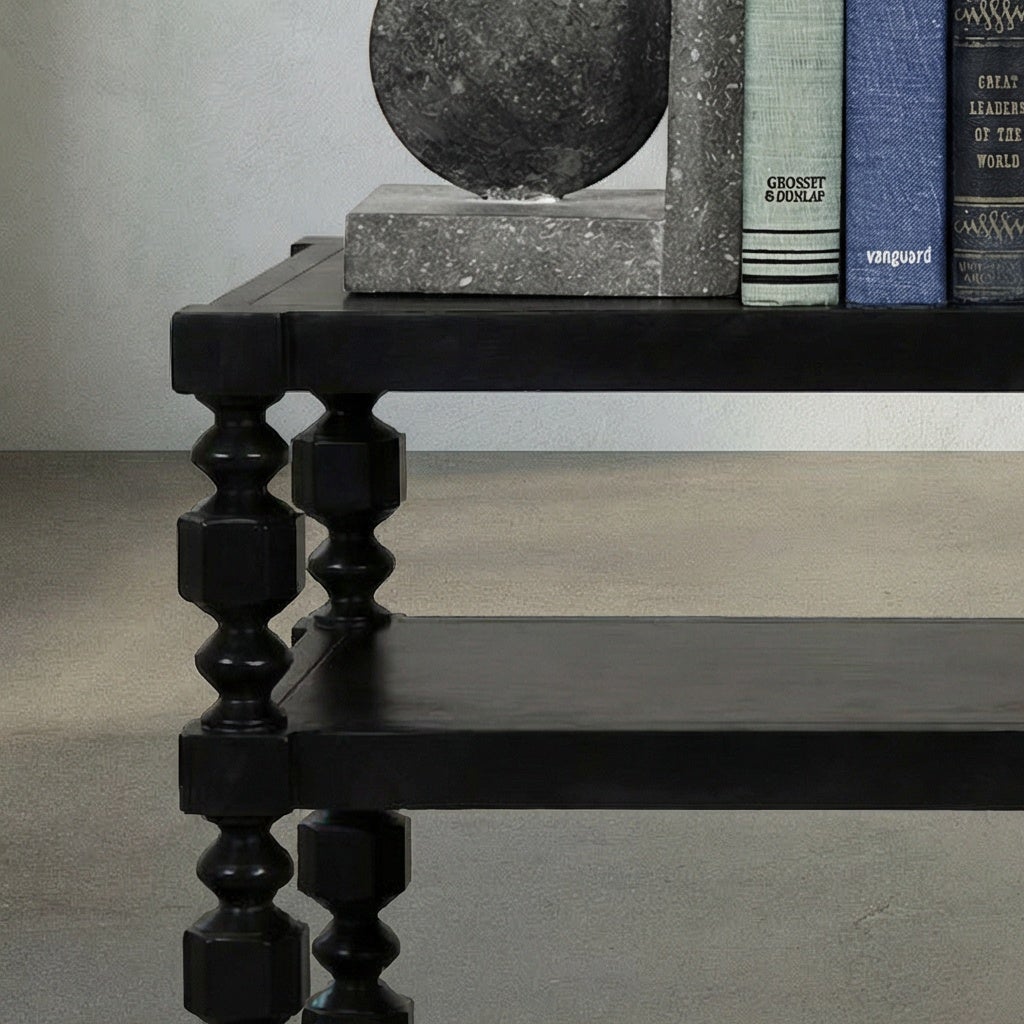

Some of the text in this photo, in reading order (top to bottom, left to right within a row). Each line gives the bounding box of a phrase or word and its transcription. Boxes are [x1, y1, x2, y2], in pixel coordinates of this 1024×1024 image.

[974, 127, 991, 142] OF
[976, 154, 1020, 168] WORLD
[866, 246, 932, 267] vanguard
